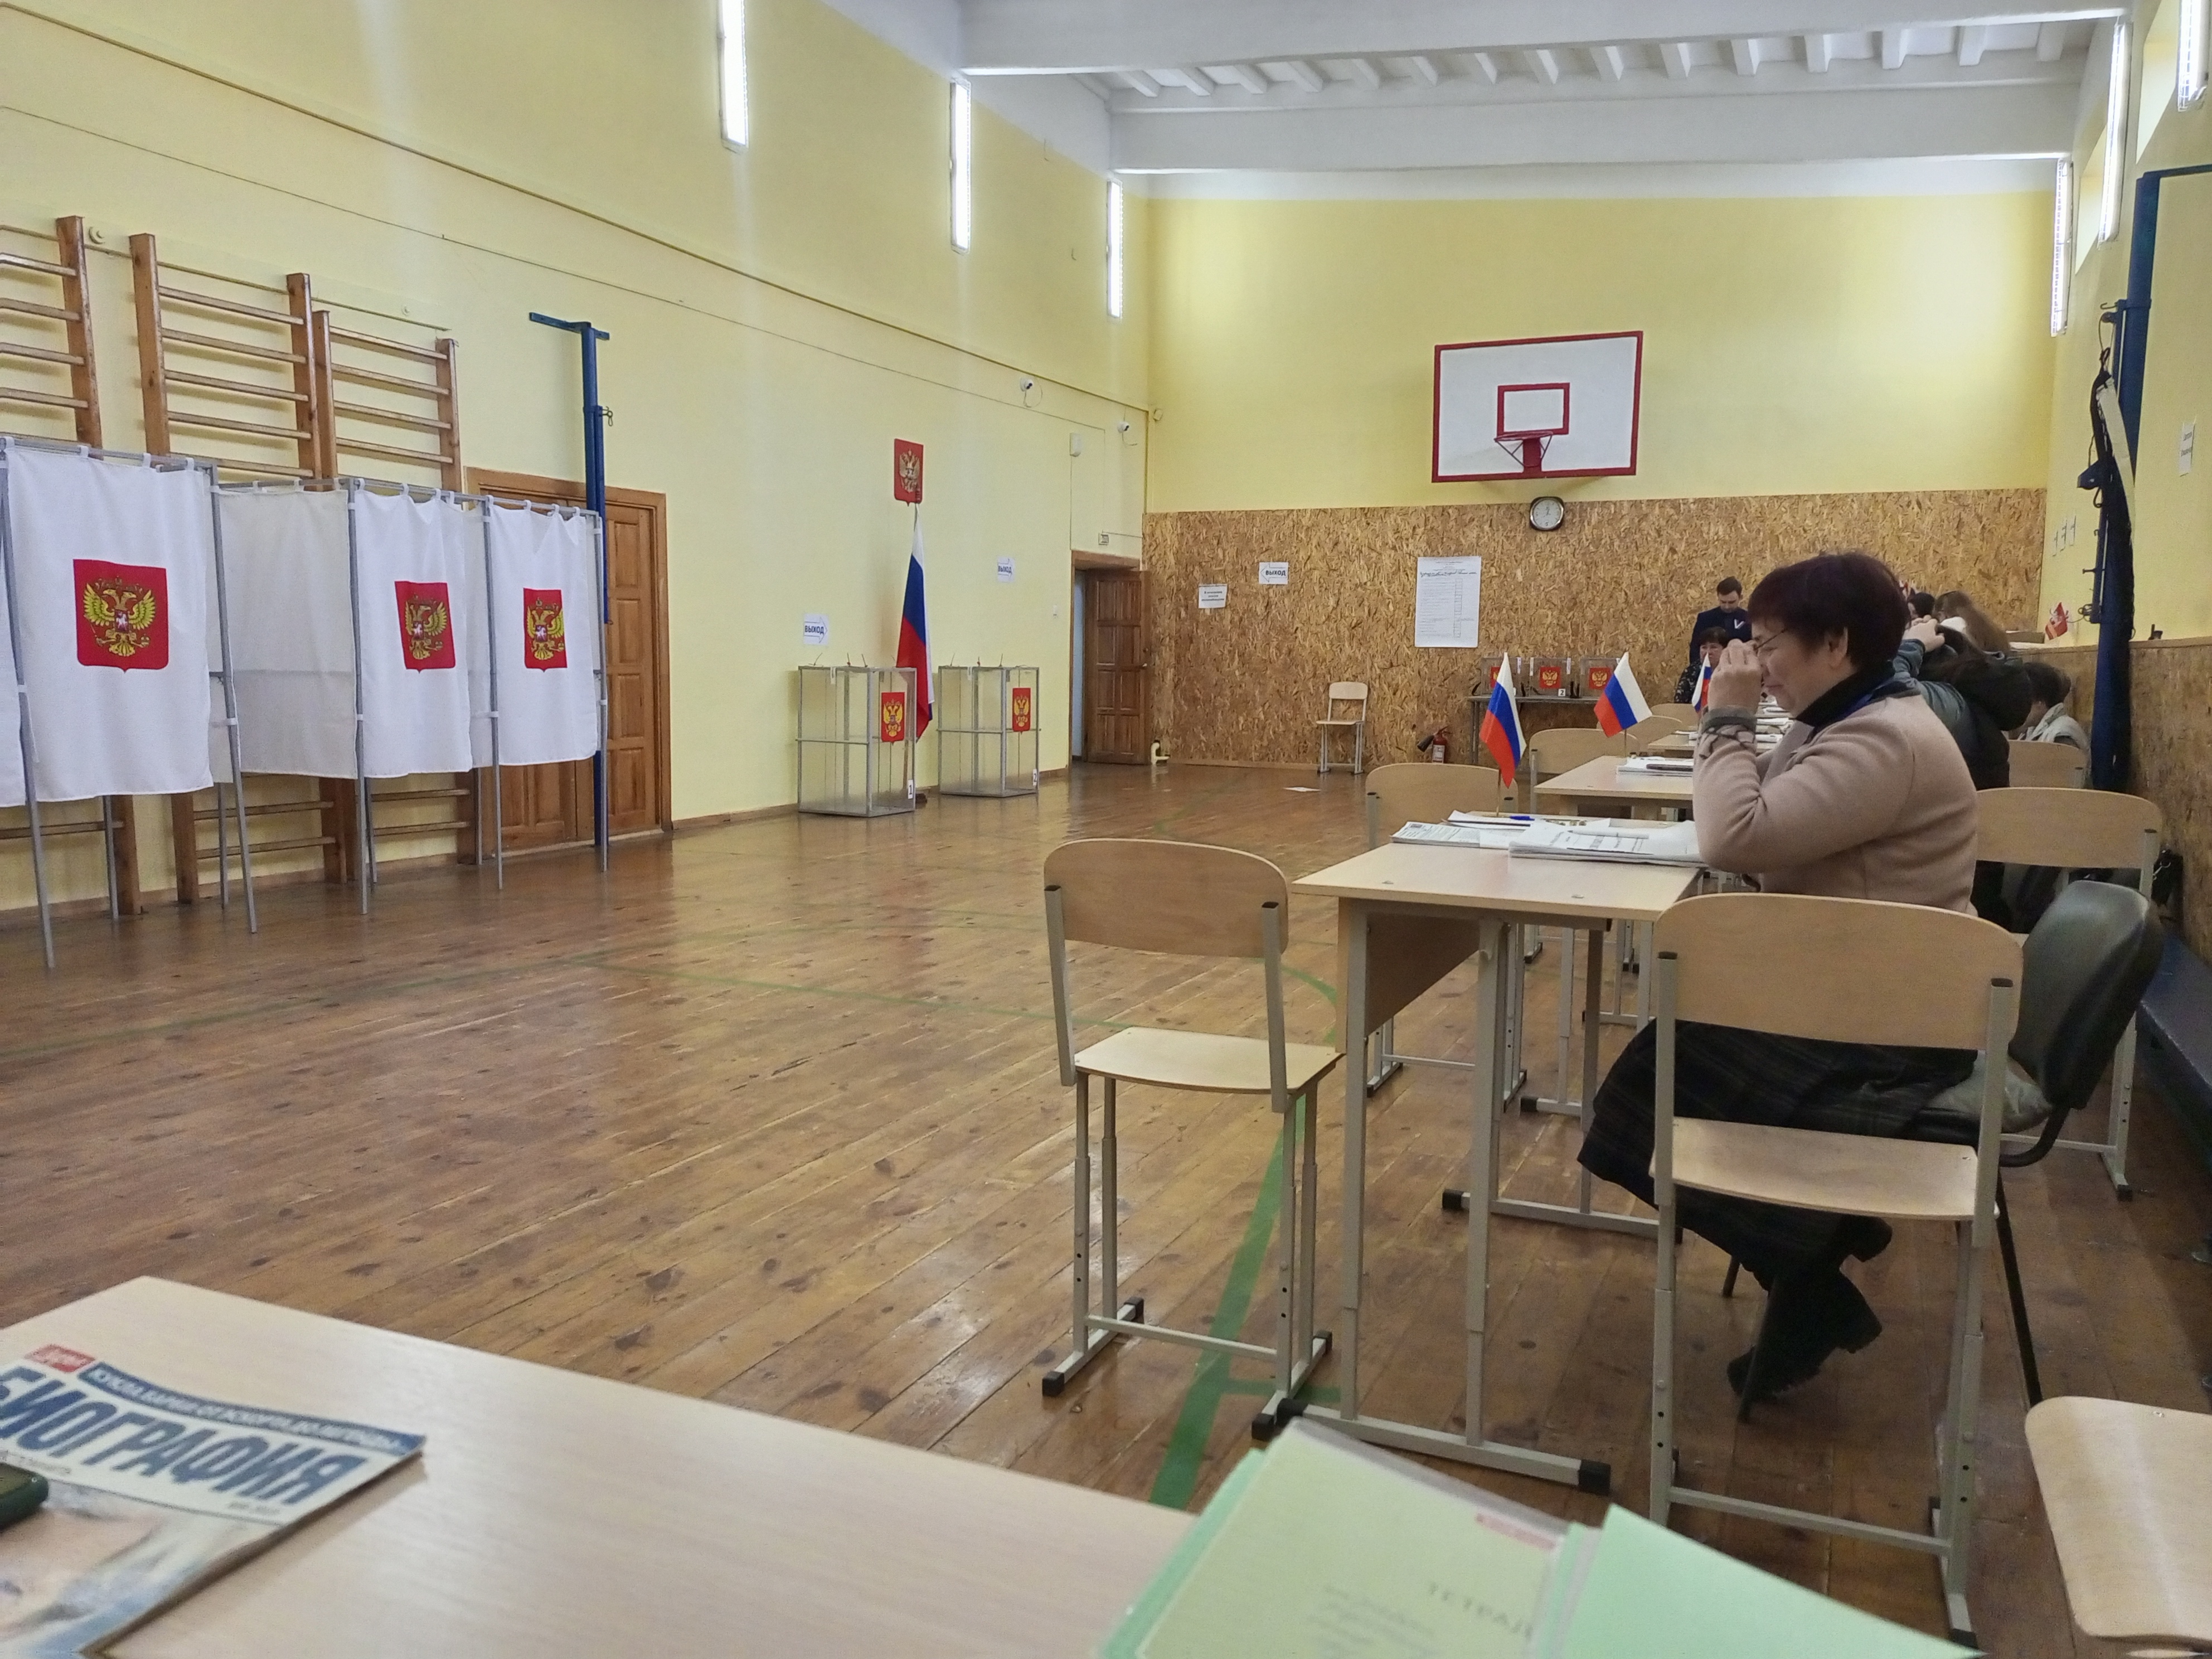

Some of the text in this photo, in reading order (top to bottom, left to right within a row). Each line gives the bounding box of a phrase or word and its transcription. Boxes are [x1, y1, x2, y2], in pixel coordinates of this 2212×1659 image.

[804, 625, 824, 634] ВЫХОД
[1034, 773, 1037, 783] 2
[909, 784, 913, 795] 1
